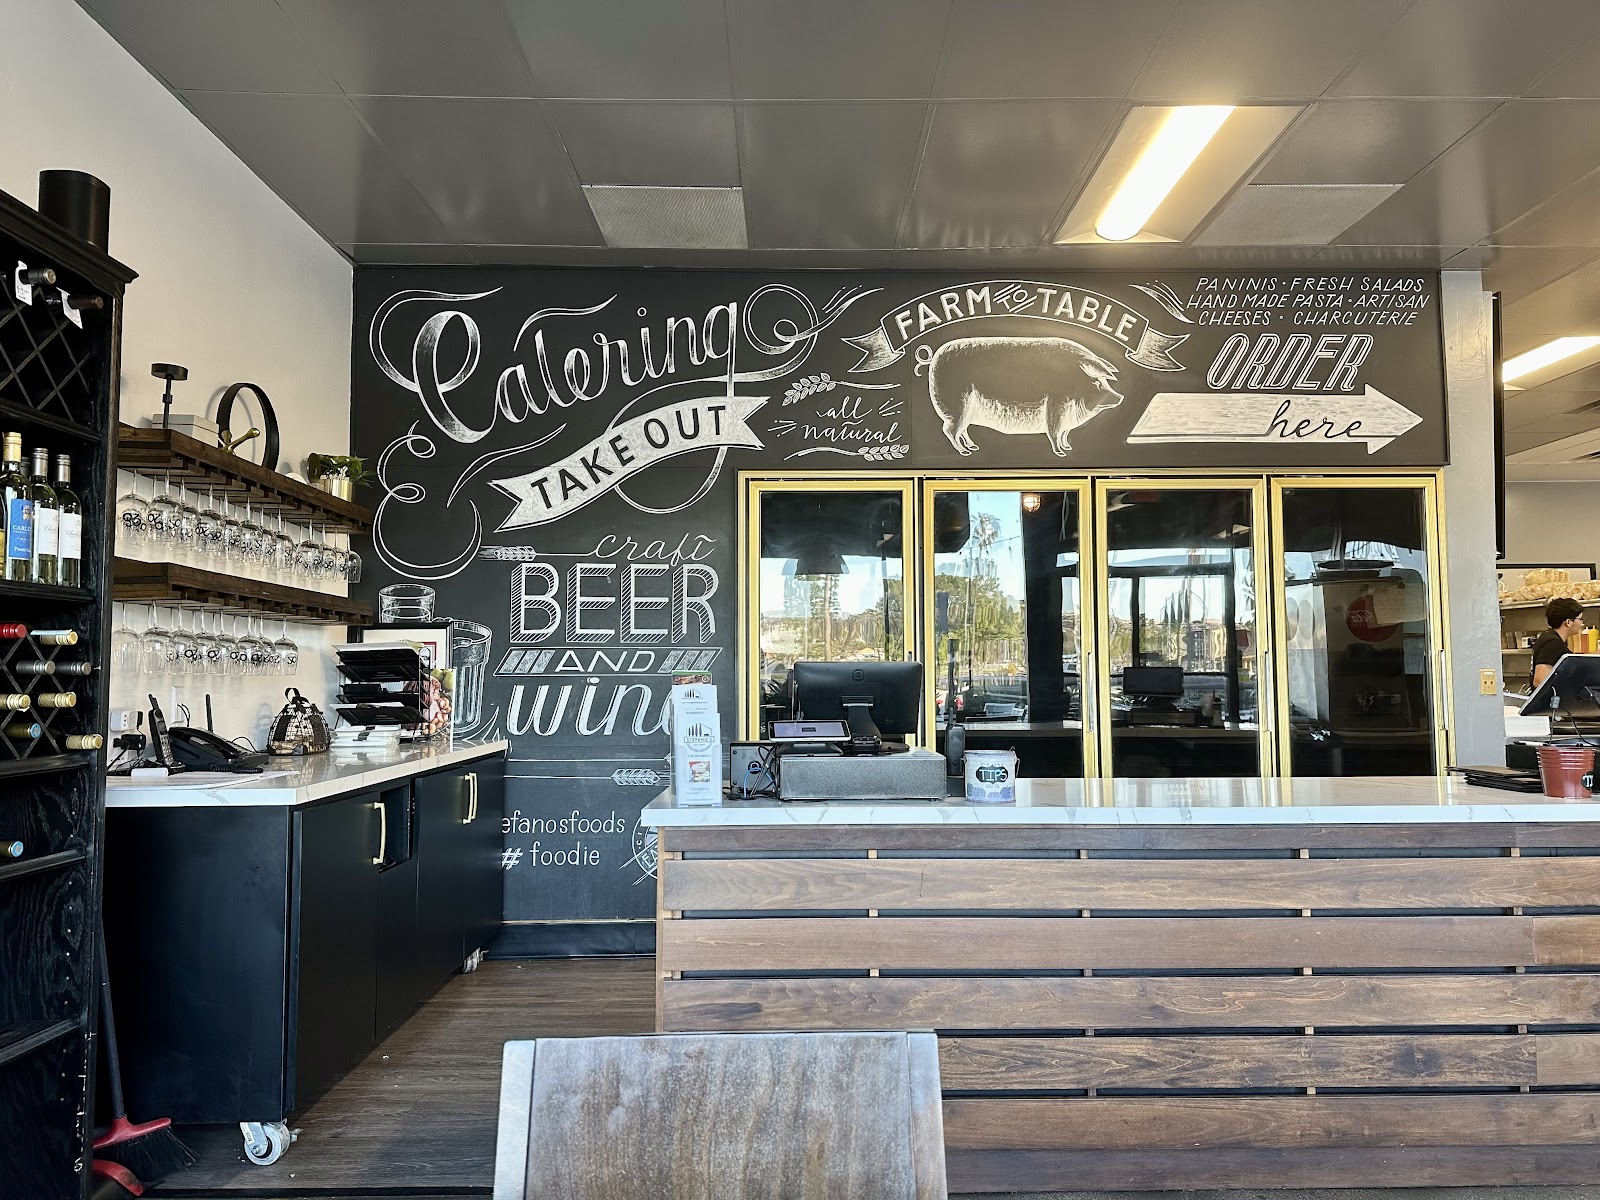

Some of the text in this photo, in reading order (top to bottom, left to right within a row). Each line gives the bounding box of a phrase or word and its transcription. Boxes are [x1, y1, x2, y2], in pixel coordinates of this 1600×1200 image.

[1195, 276, 1425, 293] PANINIS FRESH SALADS
[894, 286, 1138, 342] FARM TO TABLE
[1186, 293, 1431, 310] HAND MADE PASTA ARTISAN
[1198, 310, 1419, 326] CHEESES CHARCUTERIE
[412, 299, 738, 444] Catering
[1205, 332, 1375, 392] ORDER
[815, 395, 873, 419] all
[1267, 398, 1363, 440] here
[800, 418, 902, 444] natural
[529, 404, 727, 510] TAKE OUT
[591, 532, 718, 567] craft
[509, 562, 720, 644] BEER
[554, 649, 657, 673] AND
[978, 768, 1008, 782] TIPS
[528, 841, 601, 867] foodie
